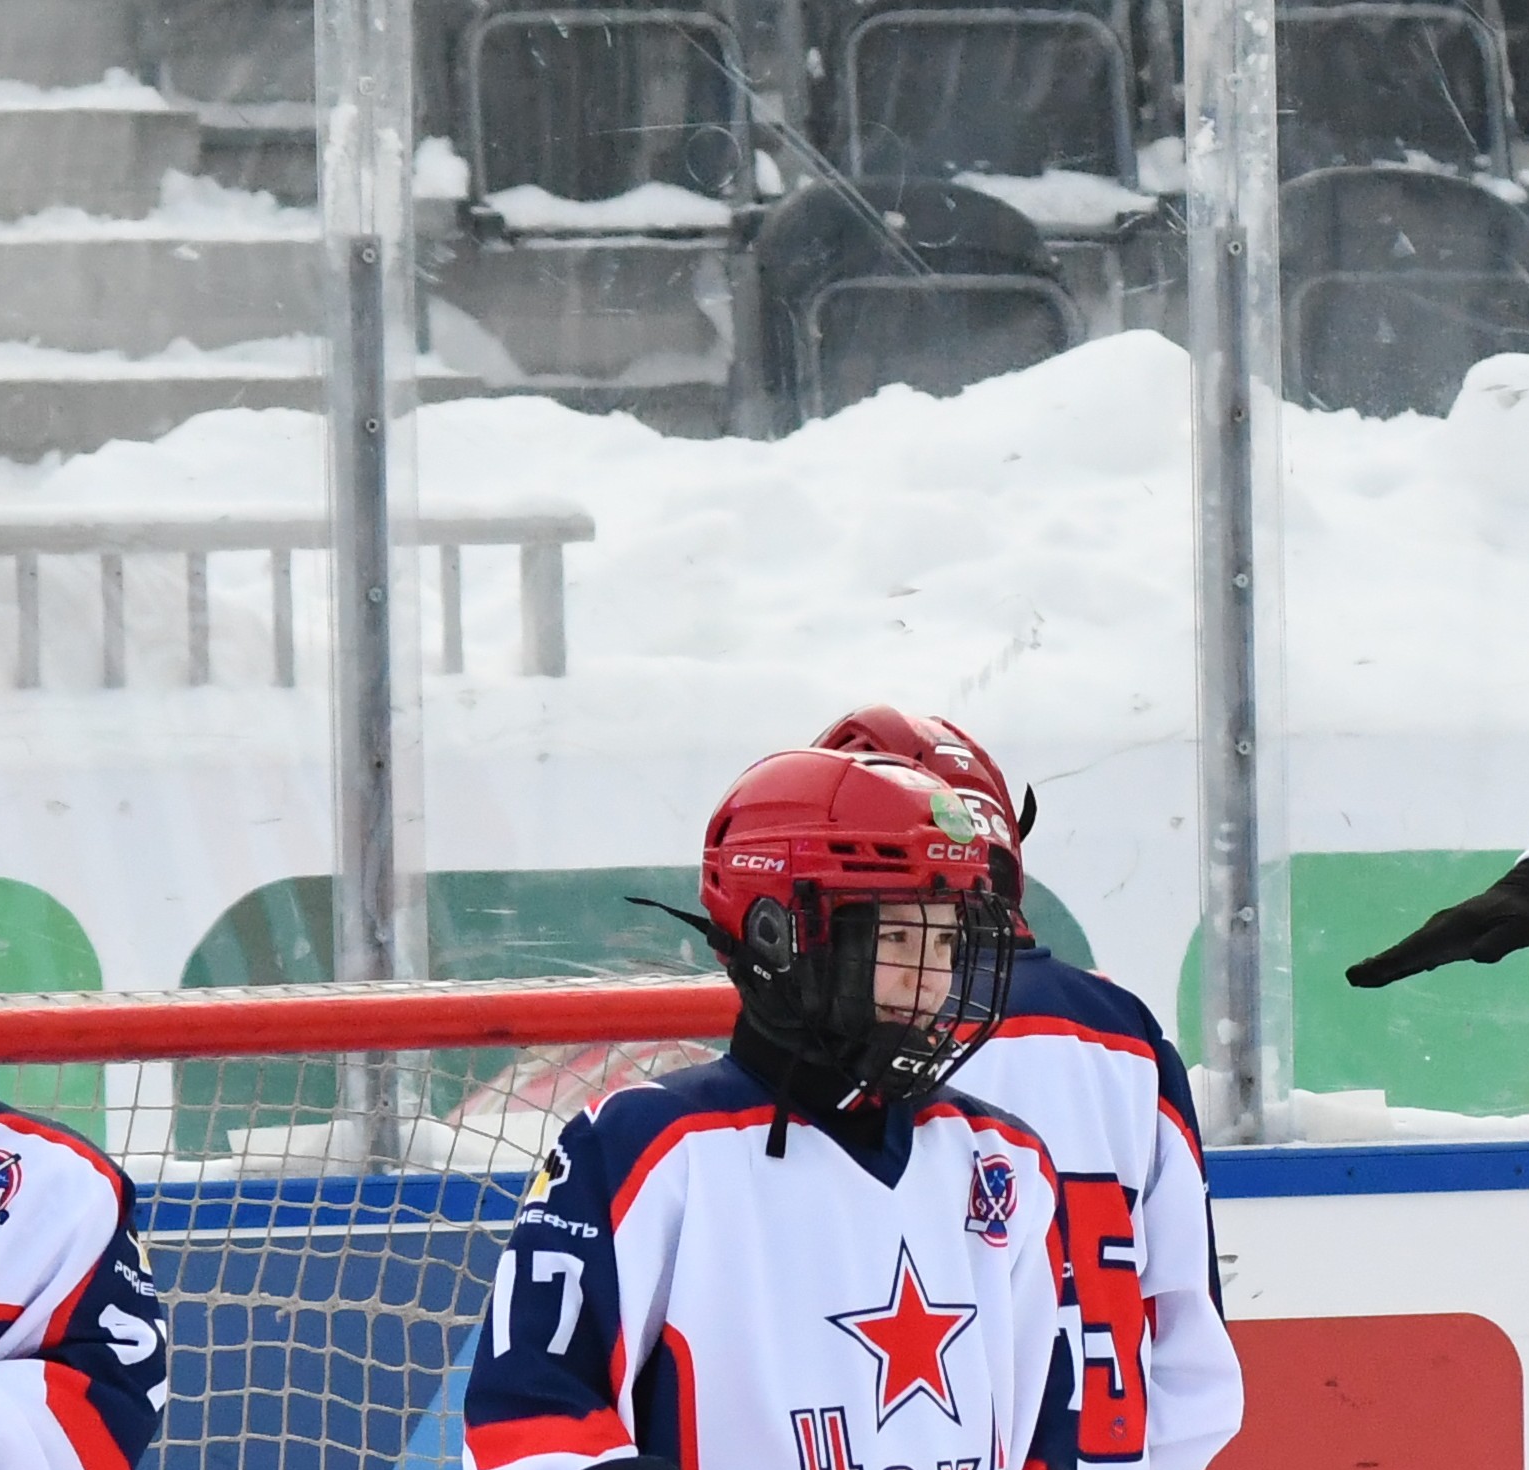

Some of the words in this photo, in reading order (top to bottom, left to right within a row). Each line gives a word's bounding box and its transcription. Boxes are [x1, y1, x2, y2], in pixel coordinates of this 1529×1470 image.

[927, 843, 979, 861] CCM
[732, 854, 785, 872] CCM
[492, 1249, 585, 1358] 17
